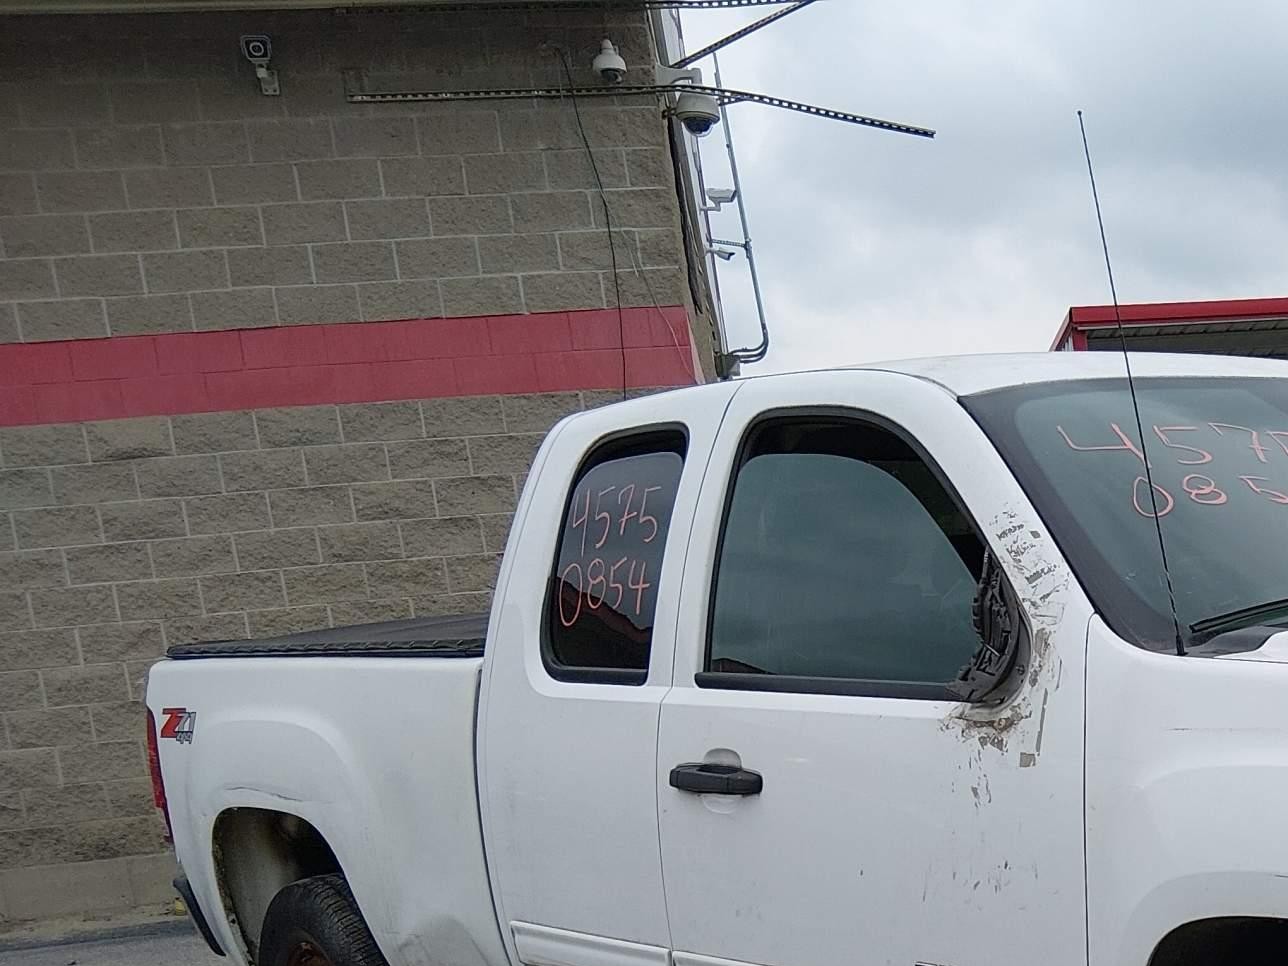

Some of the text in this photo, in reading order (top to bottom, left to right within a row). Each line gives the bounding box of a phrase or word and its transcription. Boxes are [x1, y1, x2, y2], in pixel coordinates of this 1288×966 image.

[572, 483, 662, 558] 4575
[558, 556, 650, 627] 0854
[160, 707, 197, 739] Z71
